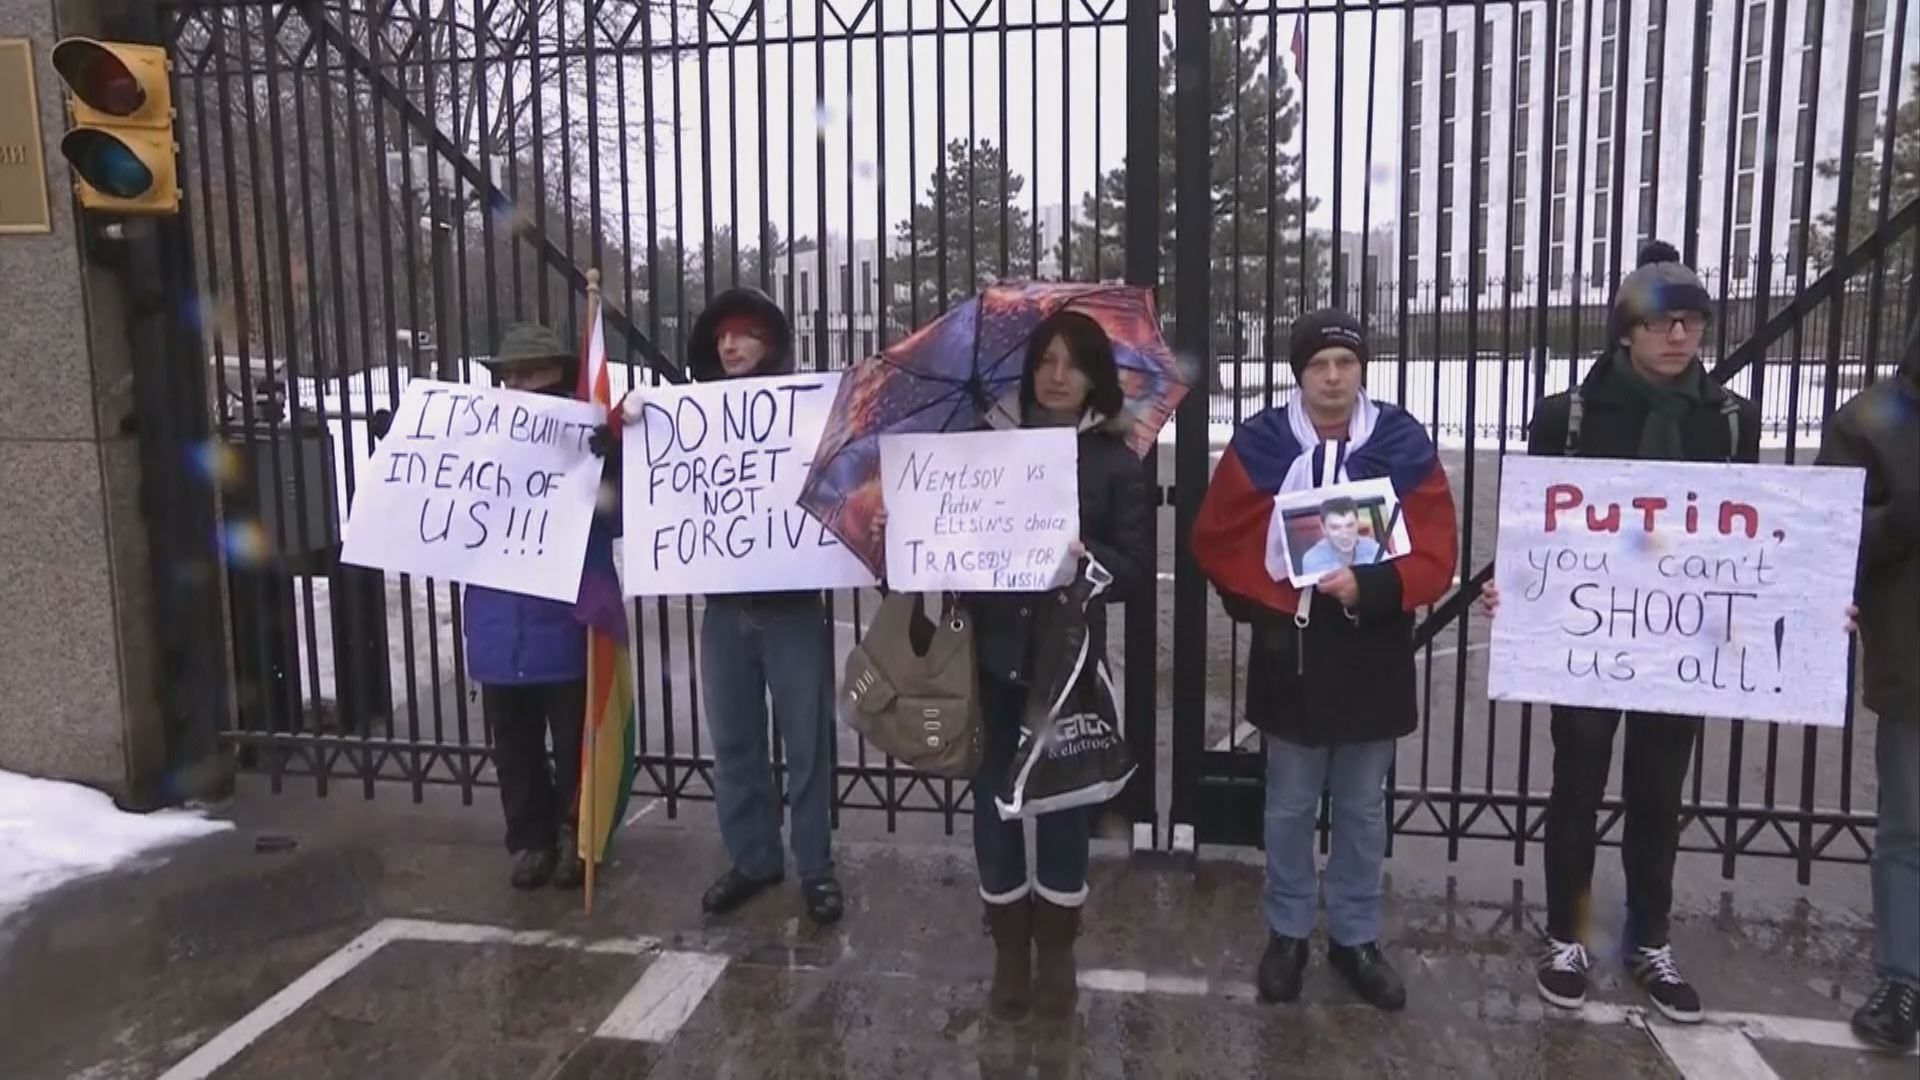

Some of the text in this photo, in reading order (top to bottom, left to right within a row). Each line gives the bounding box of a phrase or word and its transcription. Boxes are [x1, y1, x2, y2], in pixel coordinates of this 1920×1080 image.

[642, 383, 823, 467] DO NOT
[526, 470, 565, 498] OF
[649, 447, 791, 506] FORGET
[703, 486, 764, 516] NOT
[1026, 546, 1056, 567] FOR
[1524, 546, 1777, 602] you can't
[1560, 583, 1758, 643] SHOOT
[1566, 615, 1786, 694] us all!
